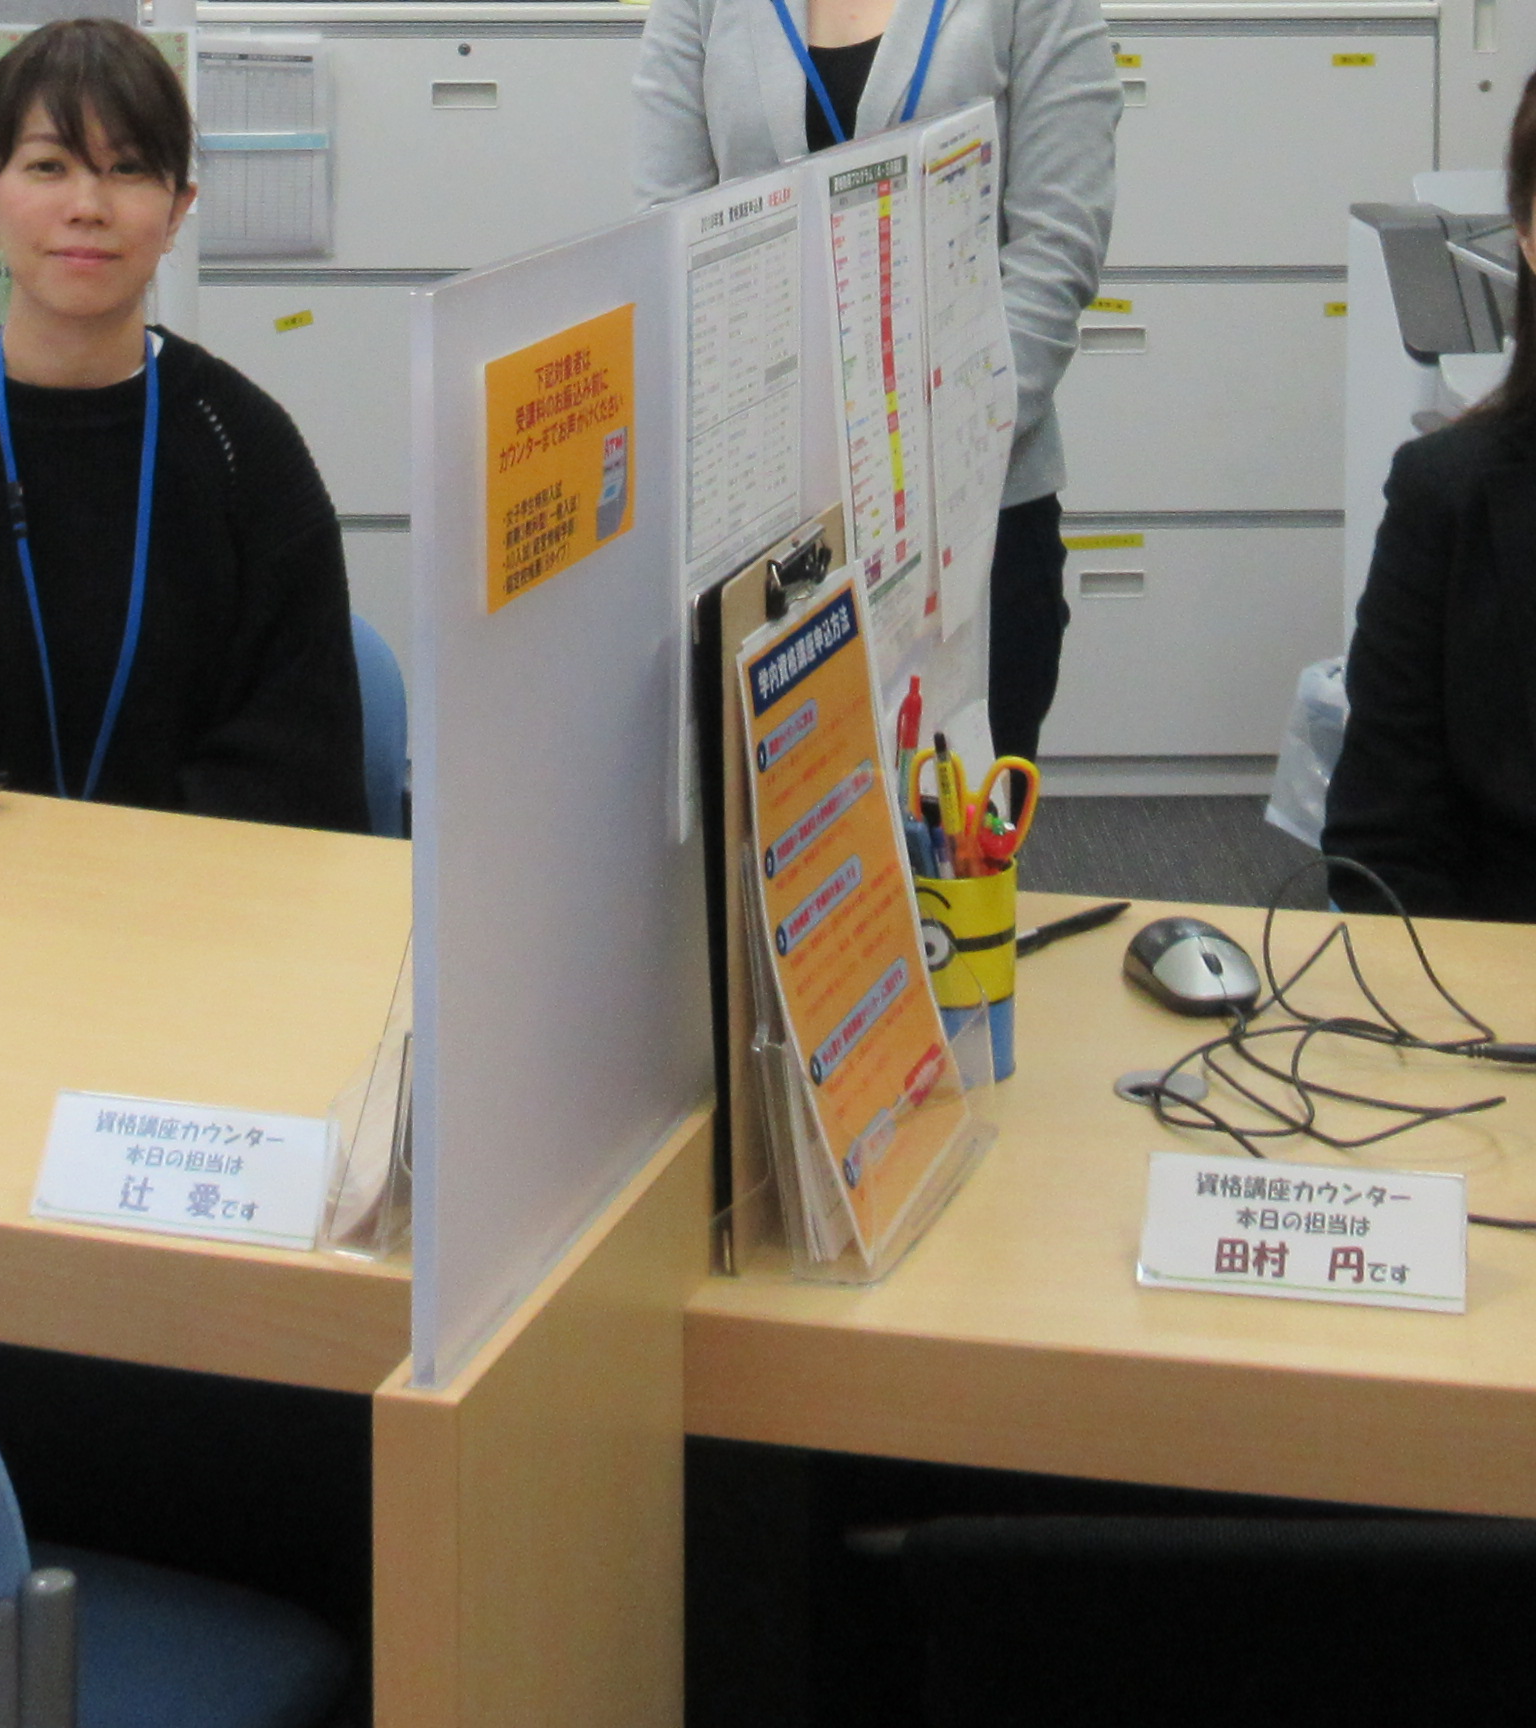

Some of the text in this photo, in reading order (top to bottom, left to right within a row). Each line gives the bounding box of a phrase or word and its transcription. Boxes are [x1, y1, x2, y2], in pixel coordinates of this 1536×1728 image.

[95, 1109, 285, 1146] 資格講座カウンター
[125, 1144, 244, 1176] 本日の担当は
[1196, 1171, 1412, 1208] 資格講座カウンター
[1236, 1206, 1371, 1237] 本日の担当は
[1214, 1237, 1290, 1278] 田村
